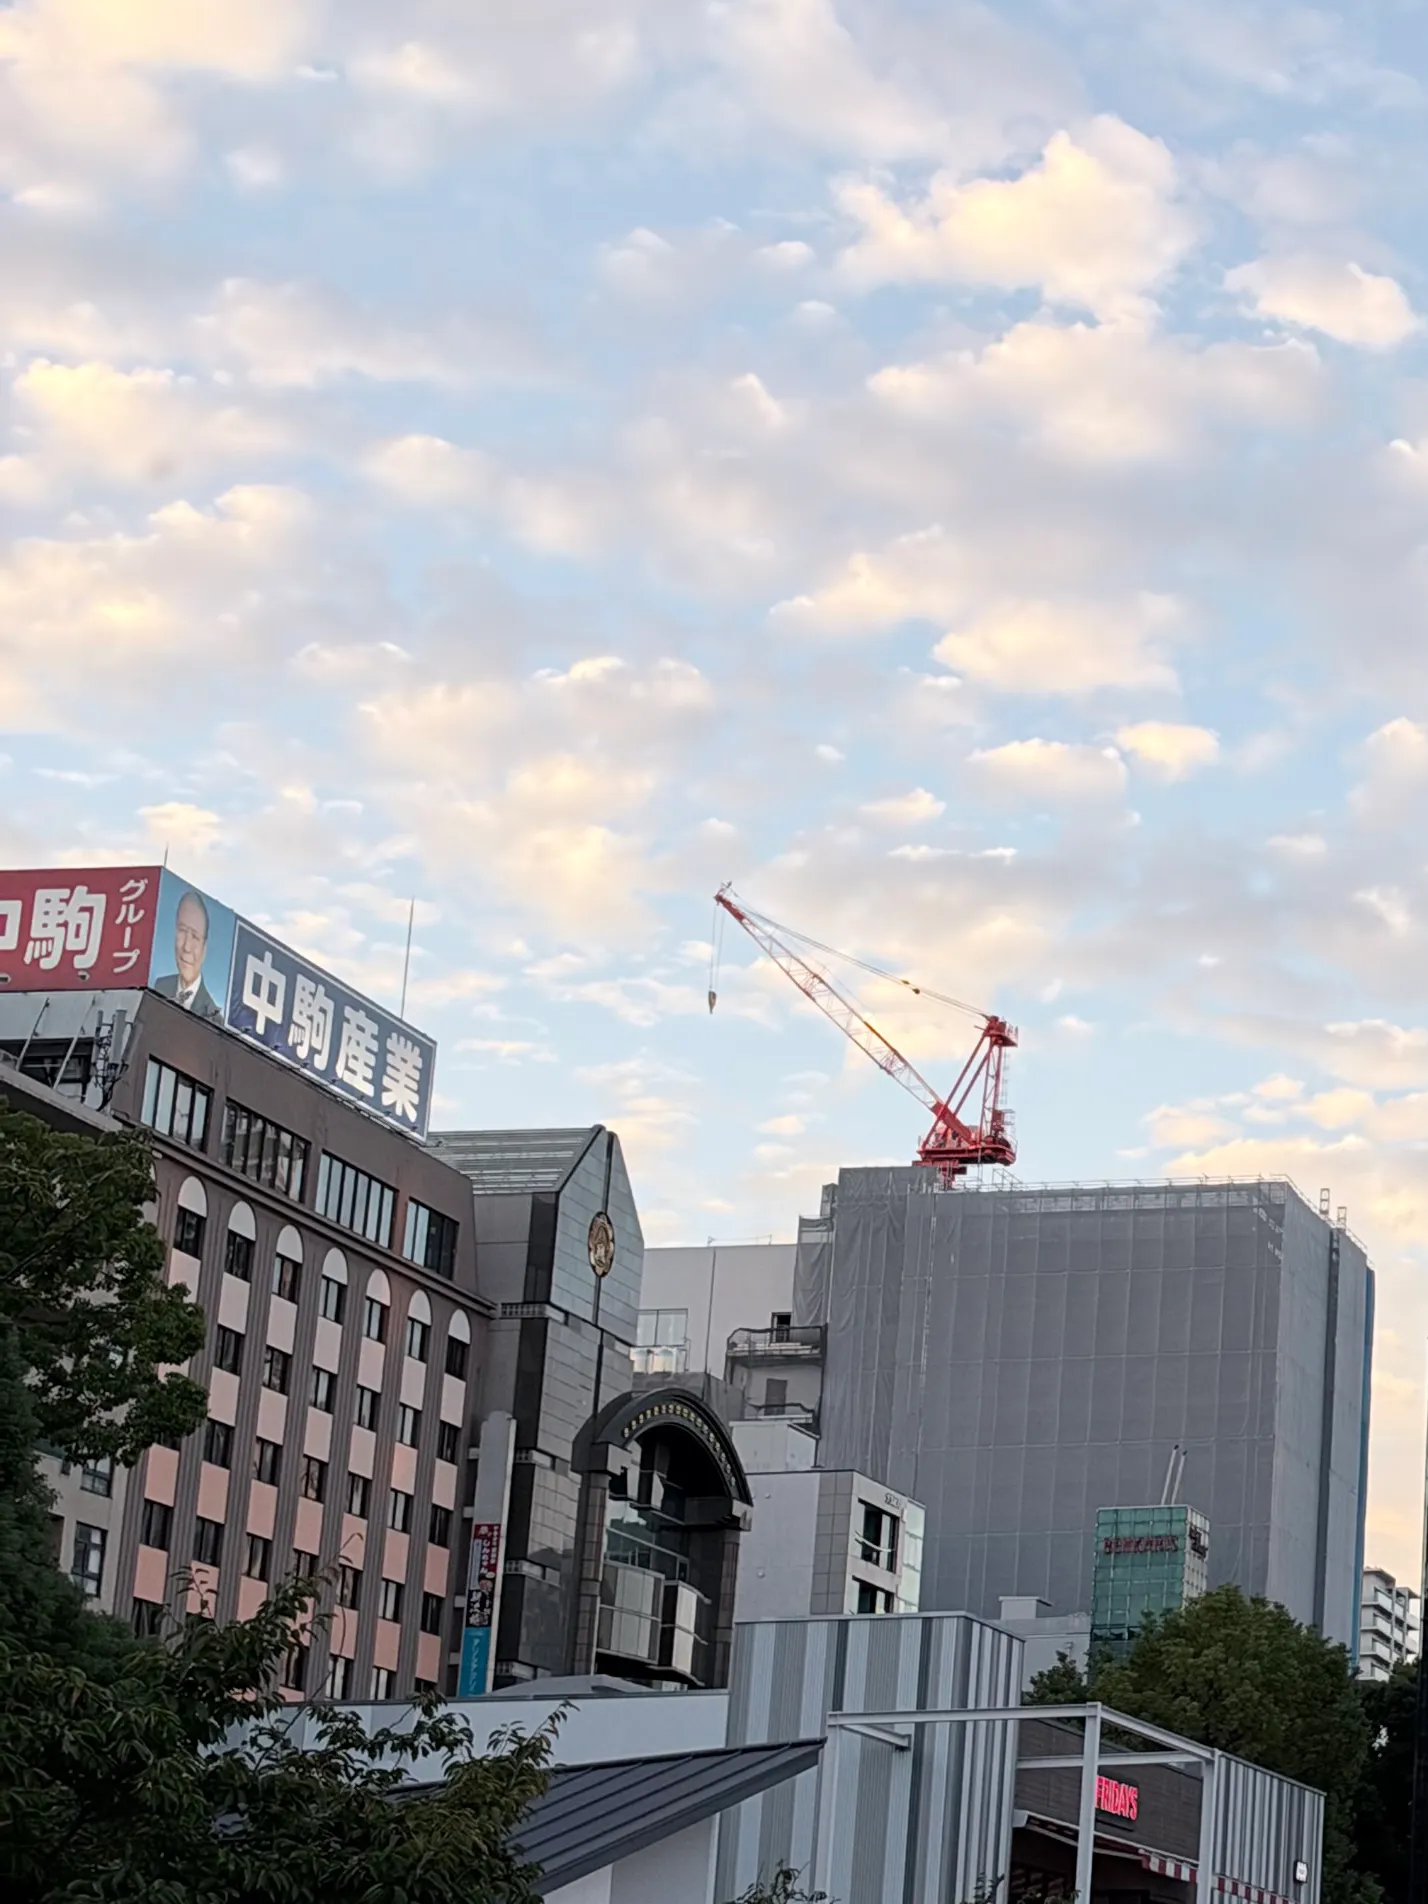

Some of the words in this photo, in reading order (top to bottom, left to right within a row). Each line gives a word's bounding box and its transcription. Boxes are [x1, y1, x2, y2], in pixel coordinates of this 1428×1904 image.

[112, 878, 149, 974] グループ
[242, 950, 423, 1123] 中駒産業
[1095, 1775, 1138, 1821] FRIDAYS
